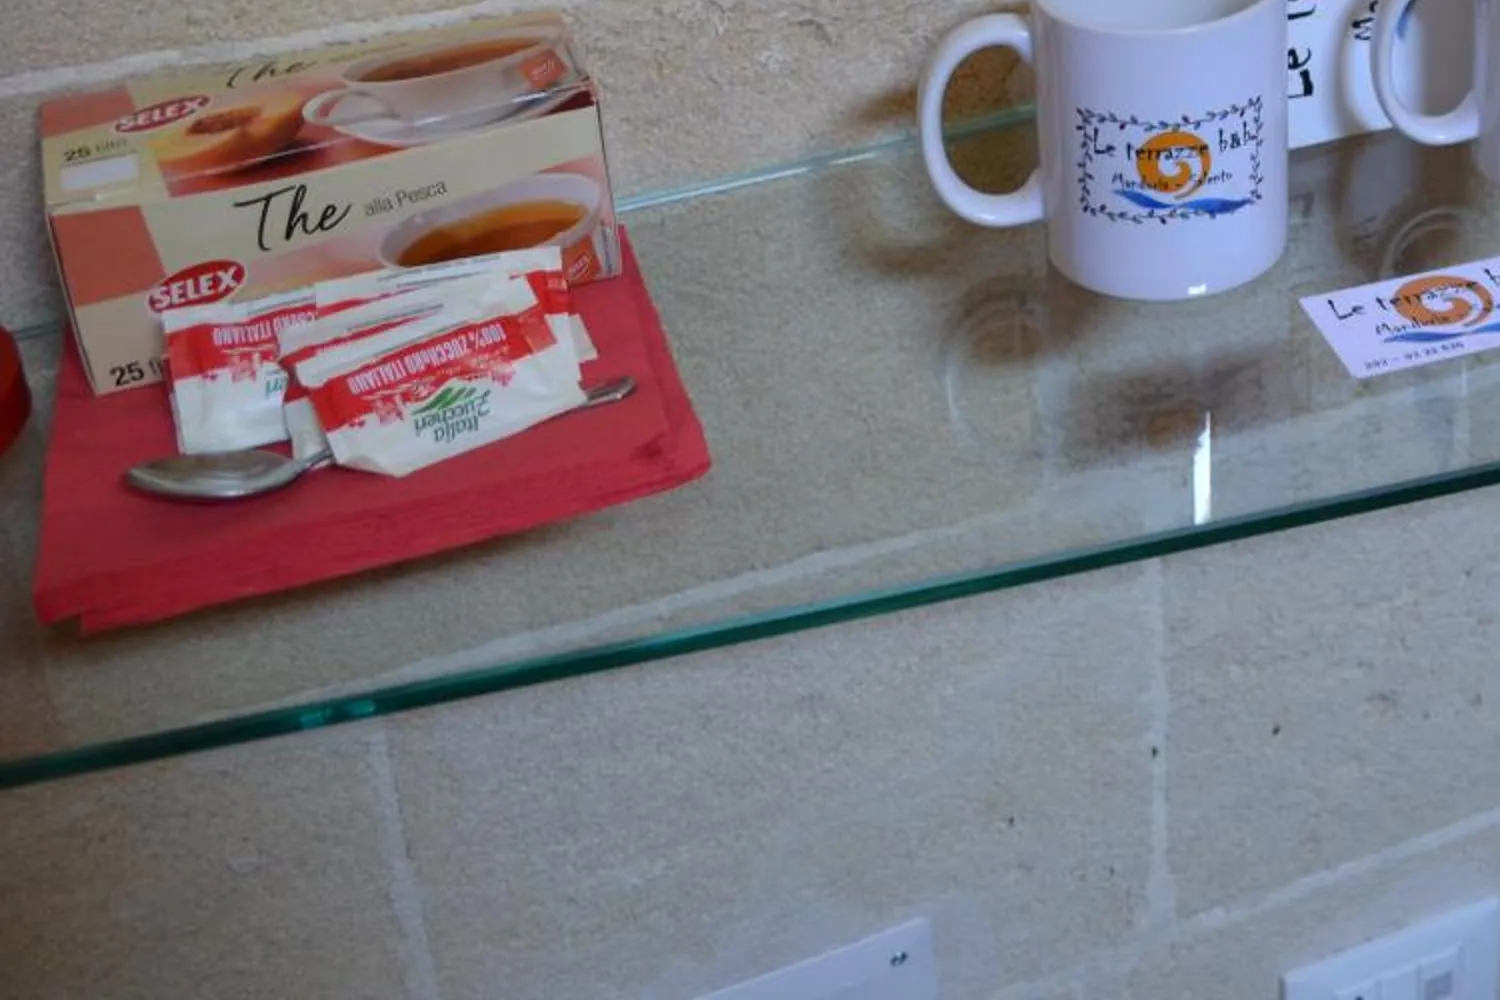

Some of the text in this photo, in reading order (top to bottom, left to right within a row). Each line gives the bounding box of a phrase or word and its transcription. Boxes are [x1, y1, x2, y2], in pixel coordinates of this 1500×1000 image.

[118, 97, 204, 131] SELEX
[233, 180, 449, 251] The alla Pesca
[151, 266, 240, 310] SELEX
[469, 323, 508, 349] 100%
[109, 358, 146, 388] 25
[346, 361, 409, 396] ITALIANO
[412, 387, 494, 438] Zuccheri
[433, 413, 481, 444] Italia
